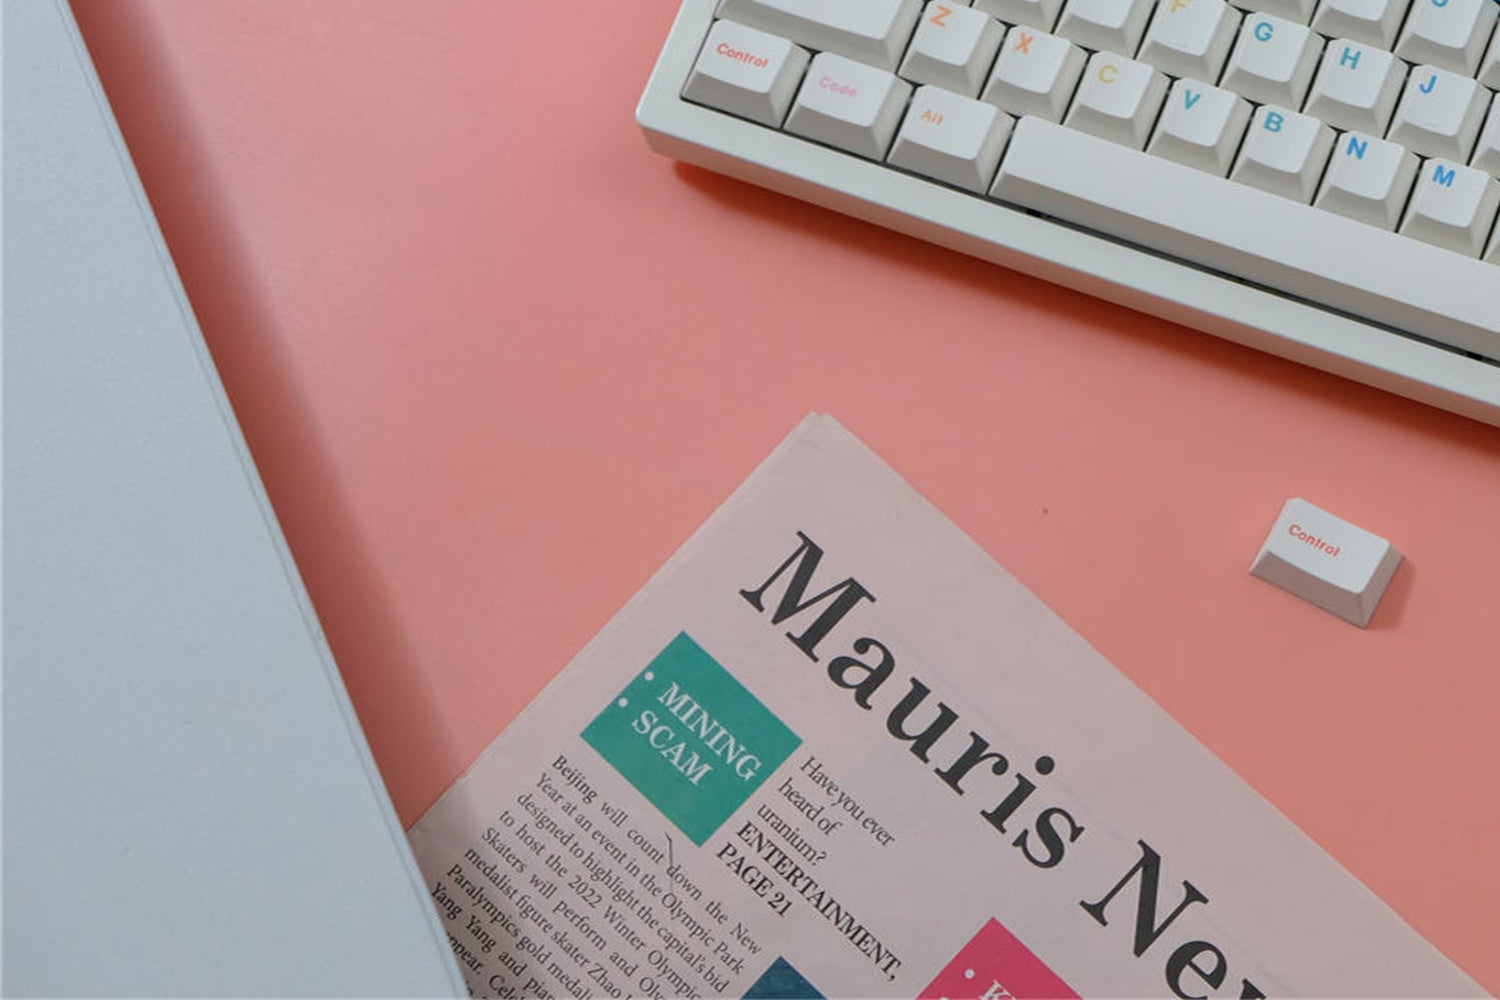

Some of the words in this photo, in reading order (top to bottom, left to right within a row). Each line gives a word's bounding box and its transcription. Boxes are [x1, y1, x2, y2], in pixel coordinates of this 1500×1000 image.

[930, 5, 953, 27] Z
[1014, 32, 1036, 55] X
[1253, 21, 1274, 42] G
[716, 42, 770, 69] Control
[1098, 64, 1119, 84] C
[1339, 46, 1362, 70] H
[1419, 74, 1438, 95] J
[818, 75, 859, 98] Code
[1184, 89, 1201, 111] V
[920, 109, 944, 126] Alt
[1263, 112, 1284, 133] B
[1346, 136, 1368, 160] N
[1432, 164, 1456, 188] M
[1287, 523, 1341, 558] Control
[632, 710, 713, 788] SCAM
[657, 681, 763, 783] MINING
[739, 530, 1085, 869] Mauris
[1079, 839, 1267, 1000] Ne
[778, 777, 826, 823] heard
[817, 820, 844, 836] of
[800, 756, 840, 797] Have
[831, 791, 866, 821] you
[862, 820, 896, 848] ever
[552, 754, 598, 804] Beijing
[600, 802, 629, 828] will
[627, 828, 666, 865] count
[666, 864, 703, 901] down
[704, 899, 729, 925] the
[729, 922, 763, 957] New
[756, 803, 828, 867] uranium?
[481, 827, 528, 874] Skaters
[529, 873, 558, 900] will
[551, 900, 608, 952] perform
[608, 951, 640, 978] and
[499, 809, 515, 828] to
[515, 823, 546, 856] host
[544, 851, 569, 878] the
[568, 875, 604, 909] 2022
[603, 904, 647, 950] Winter
[517, 792, 575, 847] designed
[568, 841, 585, 858] to
[582, 853, 641, 914] highlight
[635, 904, 660, 930] the
[703, 965, 731, 994] bid
[535, 771, 564, 804] Year
[561, 800, 578, 817] at
[574, 815, 593, 833] an
[591, 828, 633, 866] event
[625, 857, 641, 879] in
[639, 872, 663, 899] the
[661, 891, 716, 948] Olympic
[713, 940, 746, 976] Park
[716, 842, 774, 899] PAGE
[768, 891, 793, 919] 21
[735, 820, 902, 983] ENTERTAINMENT,
[431, 881, 463, 921] Yang
[464, 914, 498, 954] Yang
[498, 950, 528, 977] and
[446, 863, 522, 938] Paralympics
[515, 935, 554, 971] gold
[463, 848, 521, 902] medalist
[514, 893, 554, 935] figure
[550, 930, 591, 968] skater
[587, 962, 622, 999] Zhao
